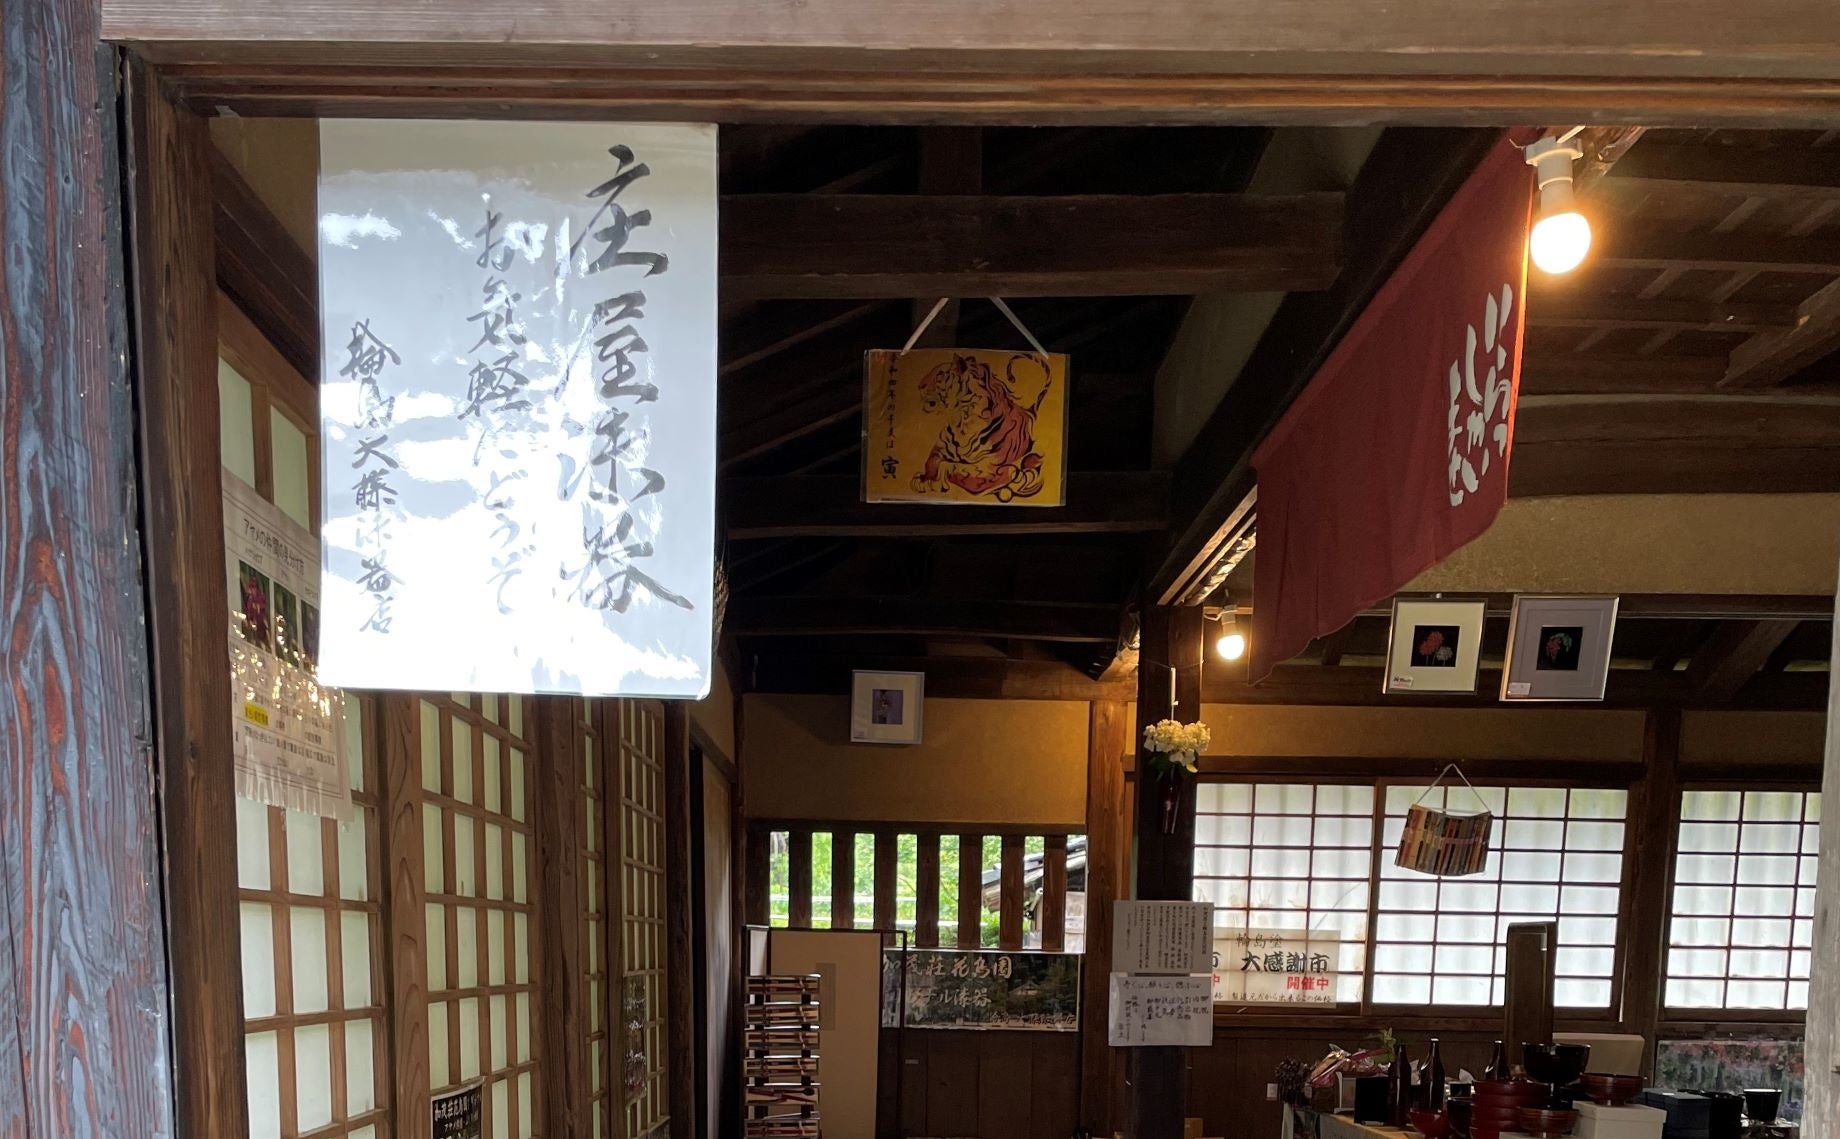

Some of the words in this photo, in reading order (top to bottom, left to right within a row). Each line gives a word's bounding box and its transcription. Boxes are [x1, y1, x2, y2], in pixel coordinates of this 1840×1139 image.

[881, 456, 900, 480] 寅
[1235, 931, 1283, 949] 輪島塗
[1240, 950, 1331, 974] 大感謝市
[1286, 975, 1330, 991] 開催中
